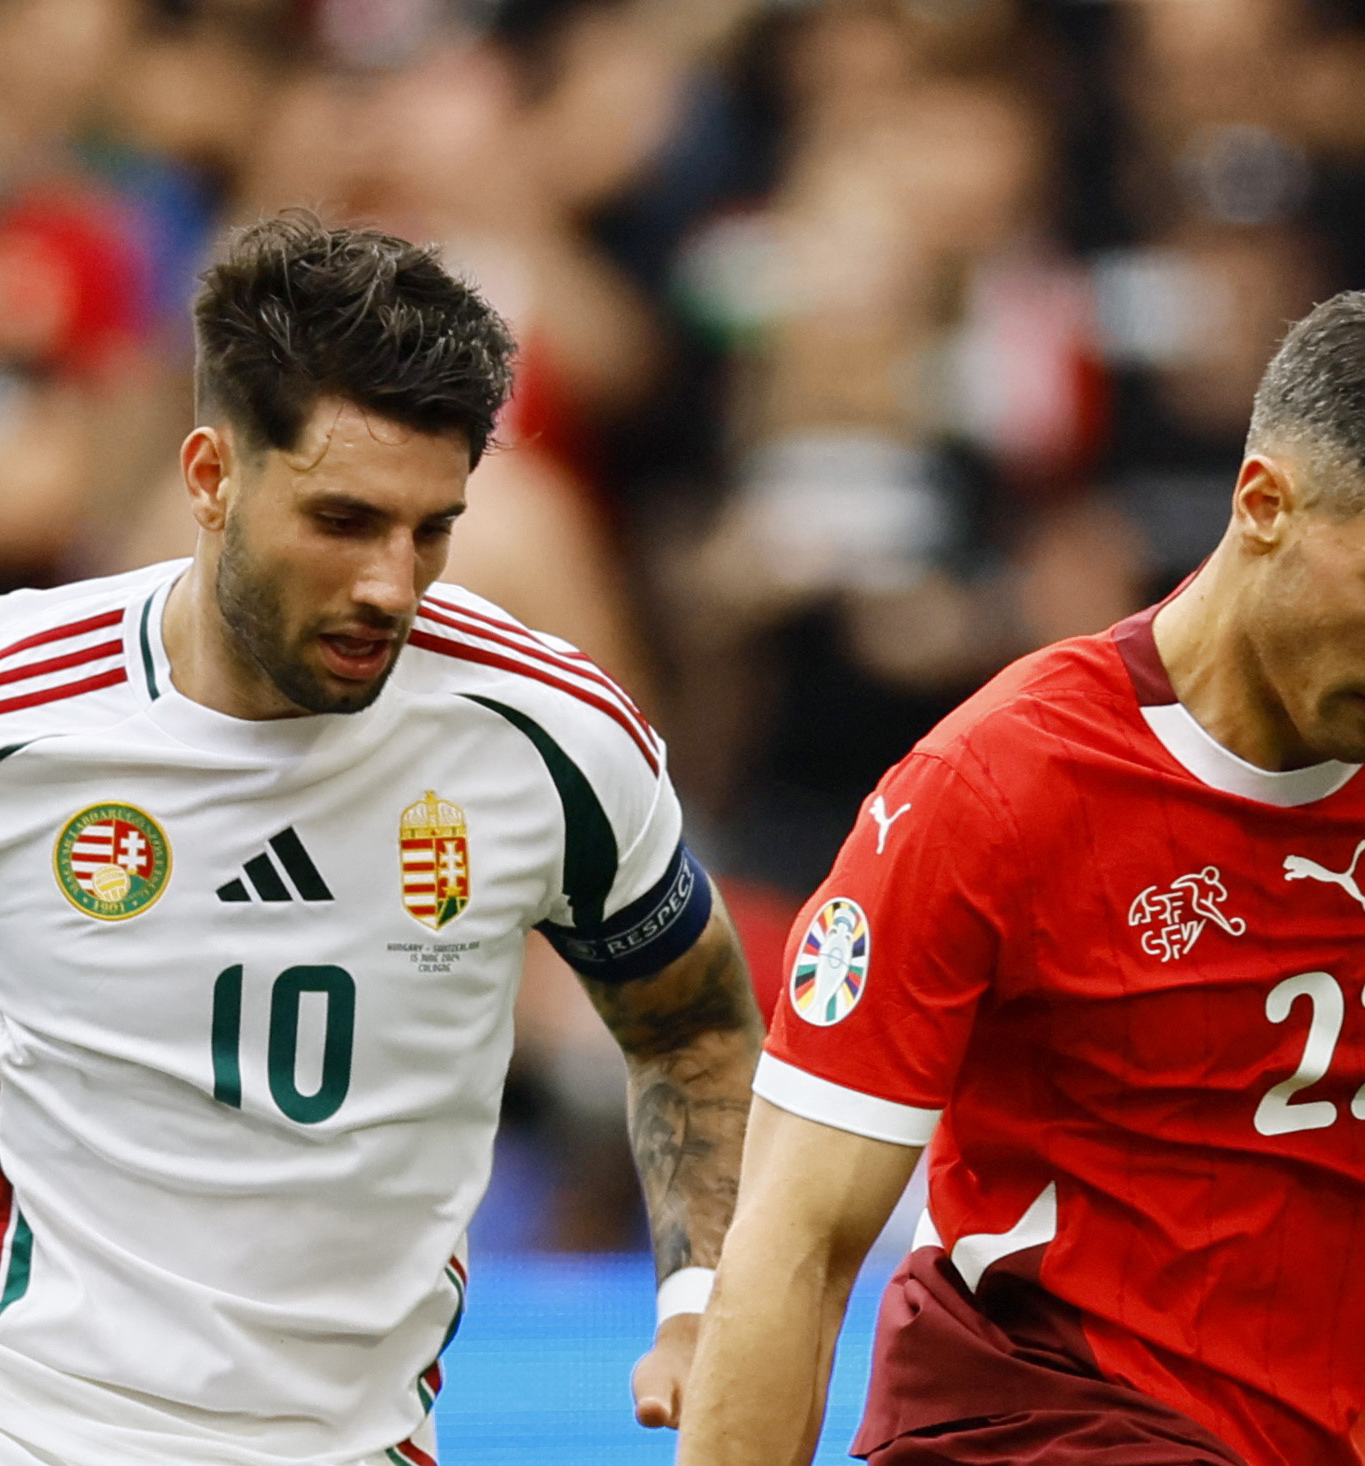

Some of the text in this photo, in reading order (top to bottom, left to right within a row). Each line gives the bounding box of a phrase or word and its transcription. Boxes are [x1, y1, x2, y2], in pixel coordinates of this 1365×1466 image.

[607, 857, 692, 954] RESPECT
[386, 943, 424, 953] HUNGARY
[418, 963, 452, 973] COLOGNE
[211, 963, 356, 1125] 10
